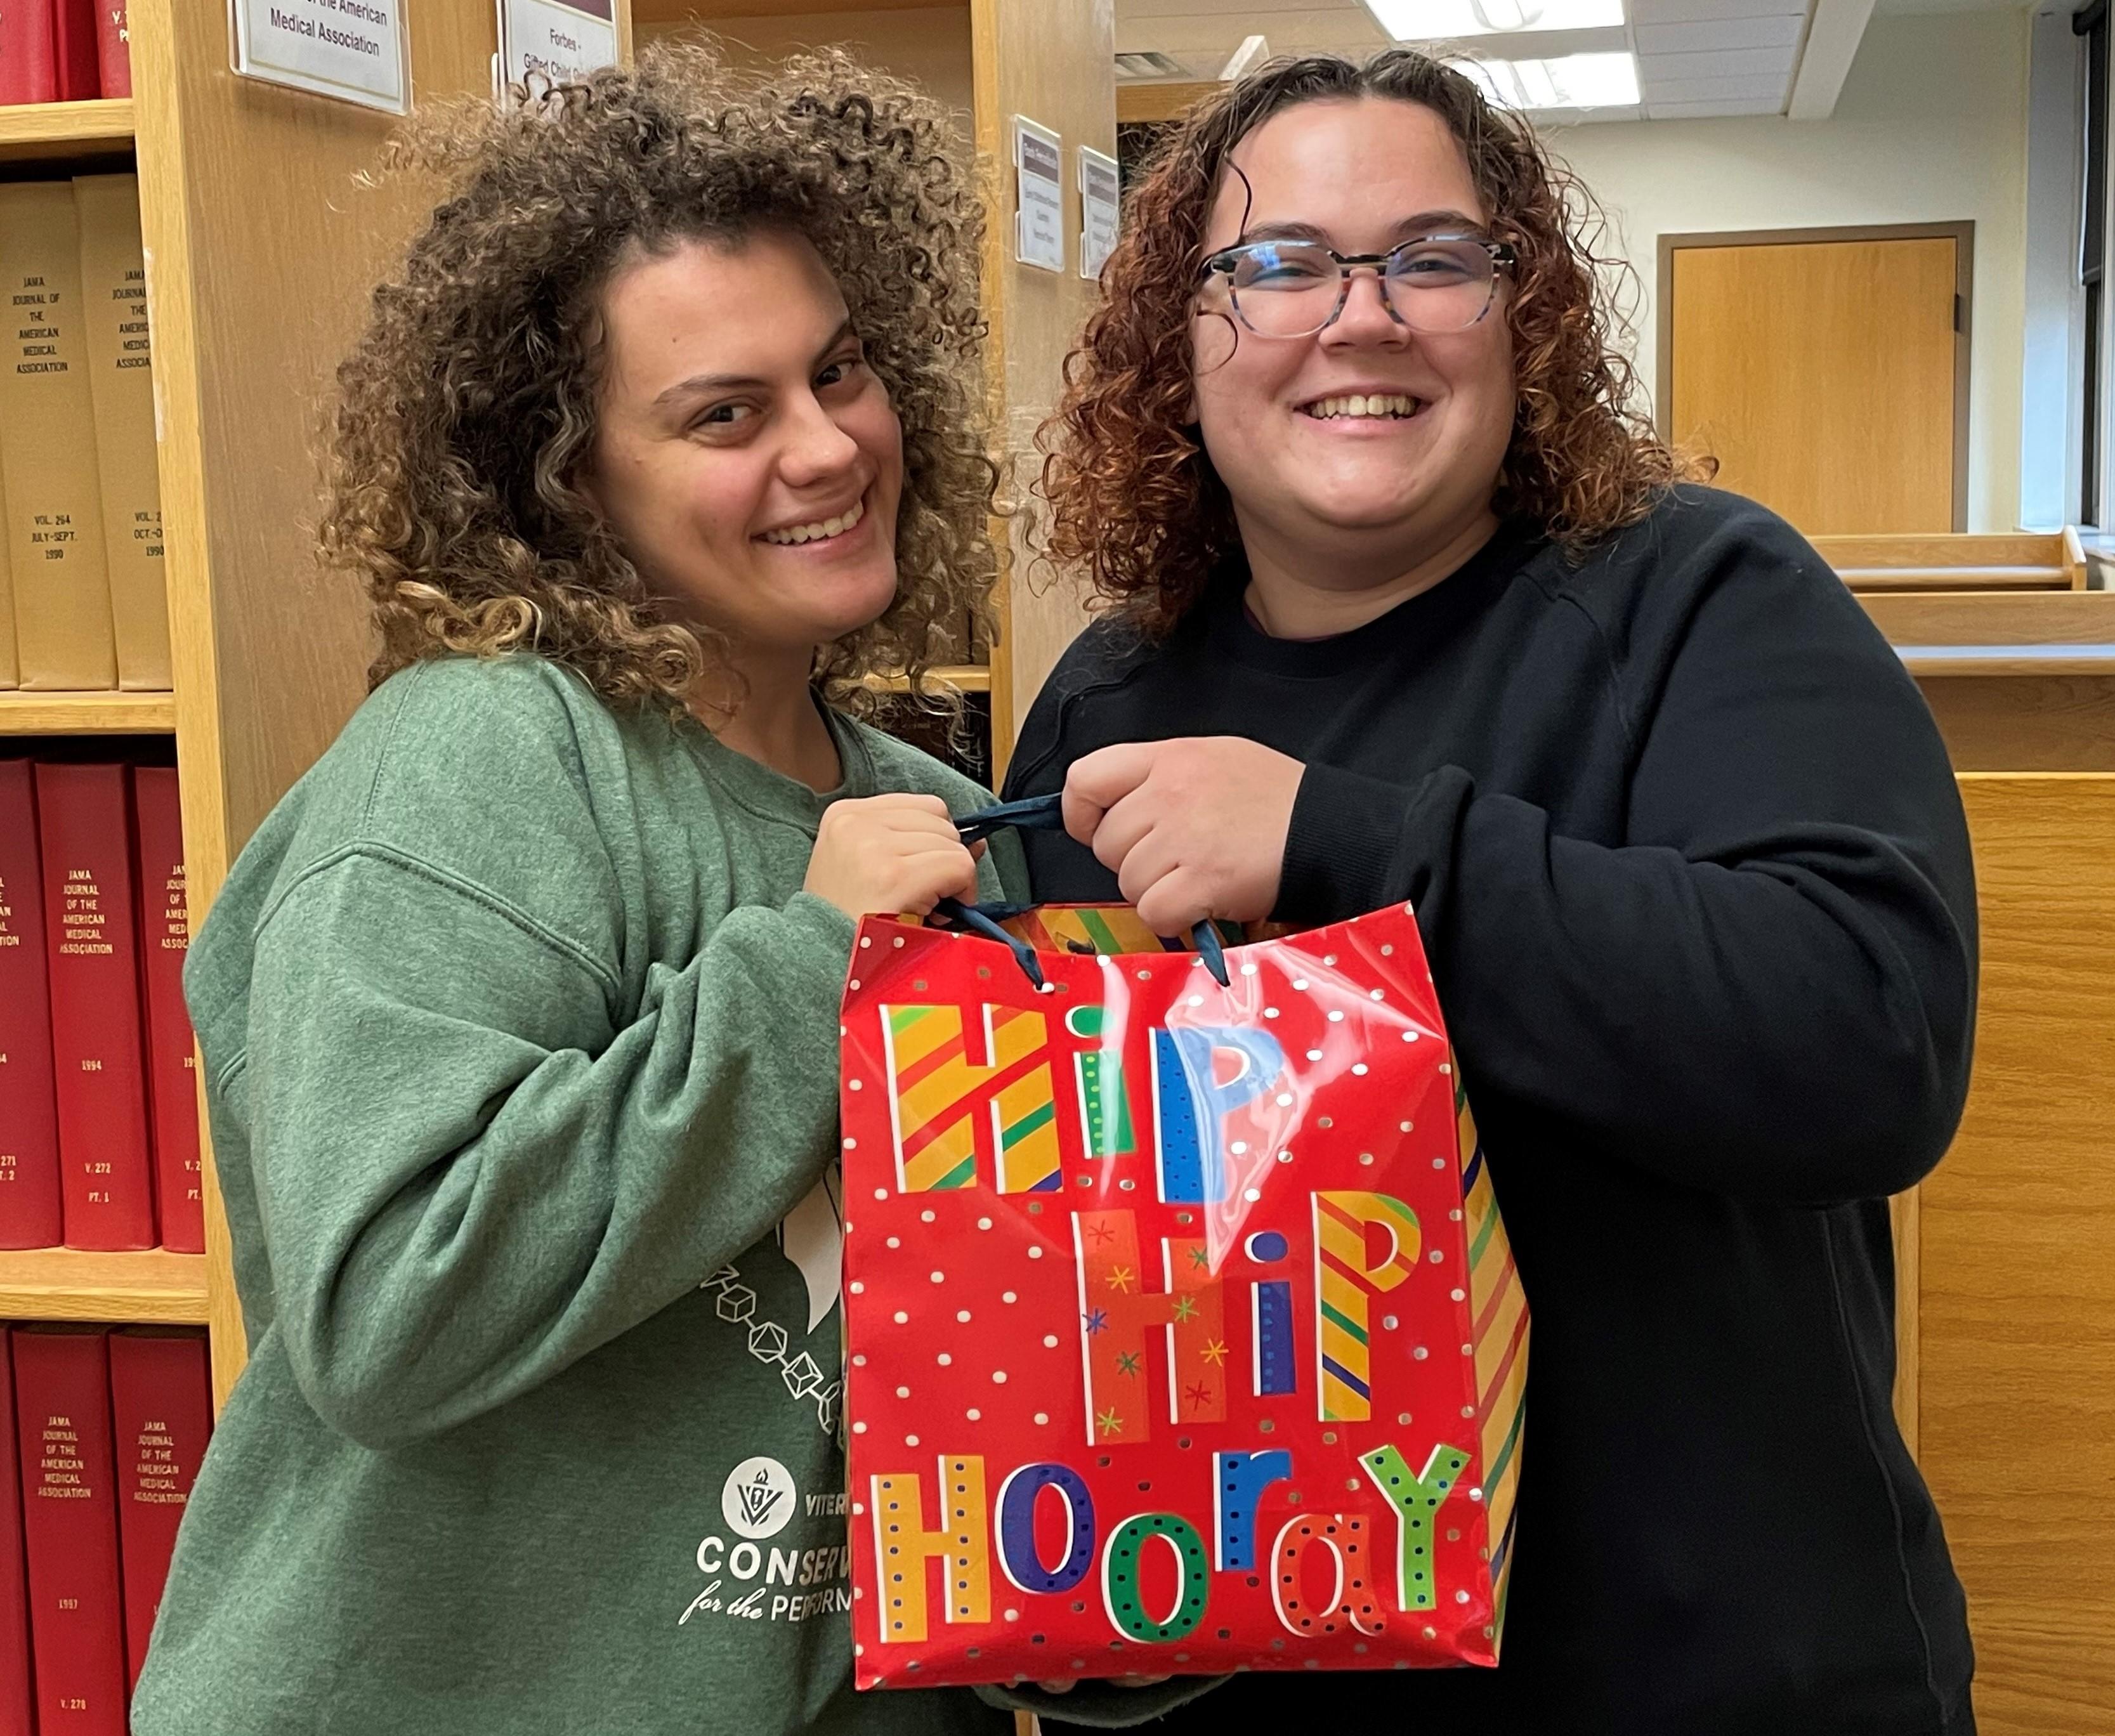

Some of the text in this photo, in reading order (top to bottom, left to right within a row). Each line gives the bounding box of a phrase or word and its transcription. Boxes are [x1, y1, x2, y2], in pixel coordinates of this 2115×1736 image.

[339, 0, 388, 26] American
[270, 8, 380, 57] Medical Association
[23, 277, 45, 287] JAMA
[13, 293, 60, 305] JOURNAL OF
[30, 311, 44, 322] THE
[19, 328, 59, 339] AMERICAN
[23, 345, 57, 356] MEDICAL
[16, 362, 68, 374] ASSOCIATION
[45, 549, 63, 559] 1990
[69, 870, 92, 880] JAMA
[63, 885, 100, 896] JOURNAL
[67, 899, 97, 910] OF THE
[169, 894, 180, 904] OF
[63, 914, 105, 925] AMERICAN
[65, 929, 101, 939] MEDICAL
[60, 944, 113, 955] ASSOCIATION
[82, 1060, 102, 1071] 1994
[1, 1156, 16, 1166] 271
[95, 1163, 111, 1173] 272
[48, 1416, 70, 1427] JAMA
[143, 1421, 166, 1432] JAMA
[43, 1430, 78, 1442] JOURNAL
[138, 1435, 174, 1447] JOURNAL
[46, 1445, 76, 1456] OF THE
[141, 1449, 172, 1461] OF THE
[41, 1459, 84, 1470] AMERICAN
[137, 1464, 180, 1475] AMERICAN
[44, 1473, 81, 1484] MEDICAL
[140, 1478, 176, 1489] MEDICAL
[38, 1487, 91, 1498] ASSOCIATION
[133, 1492, 188, 1504] ASSOCIATION
[678, 1579, 723, 1626] for
[726, 1587, 766, 1620] the
